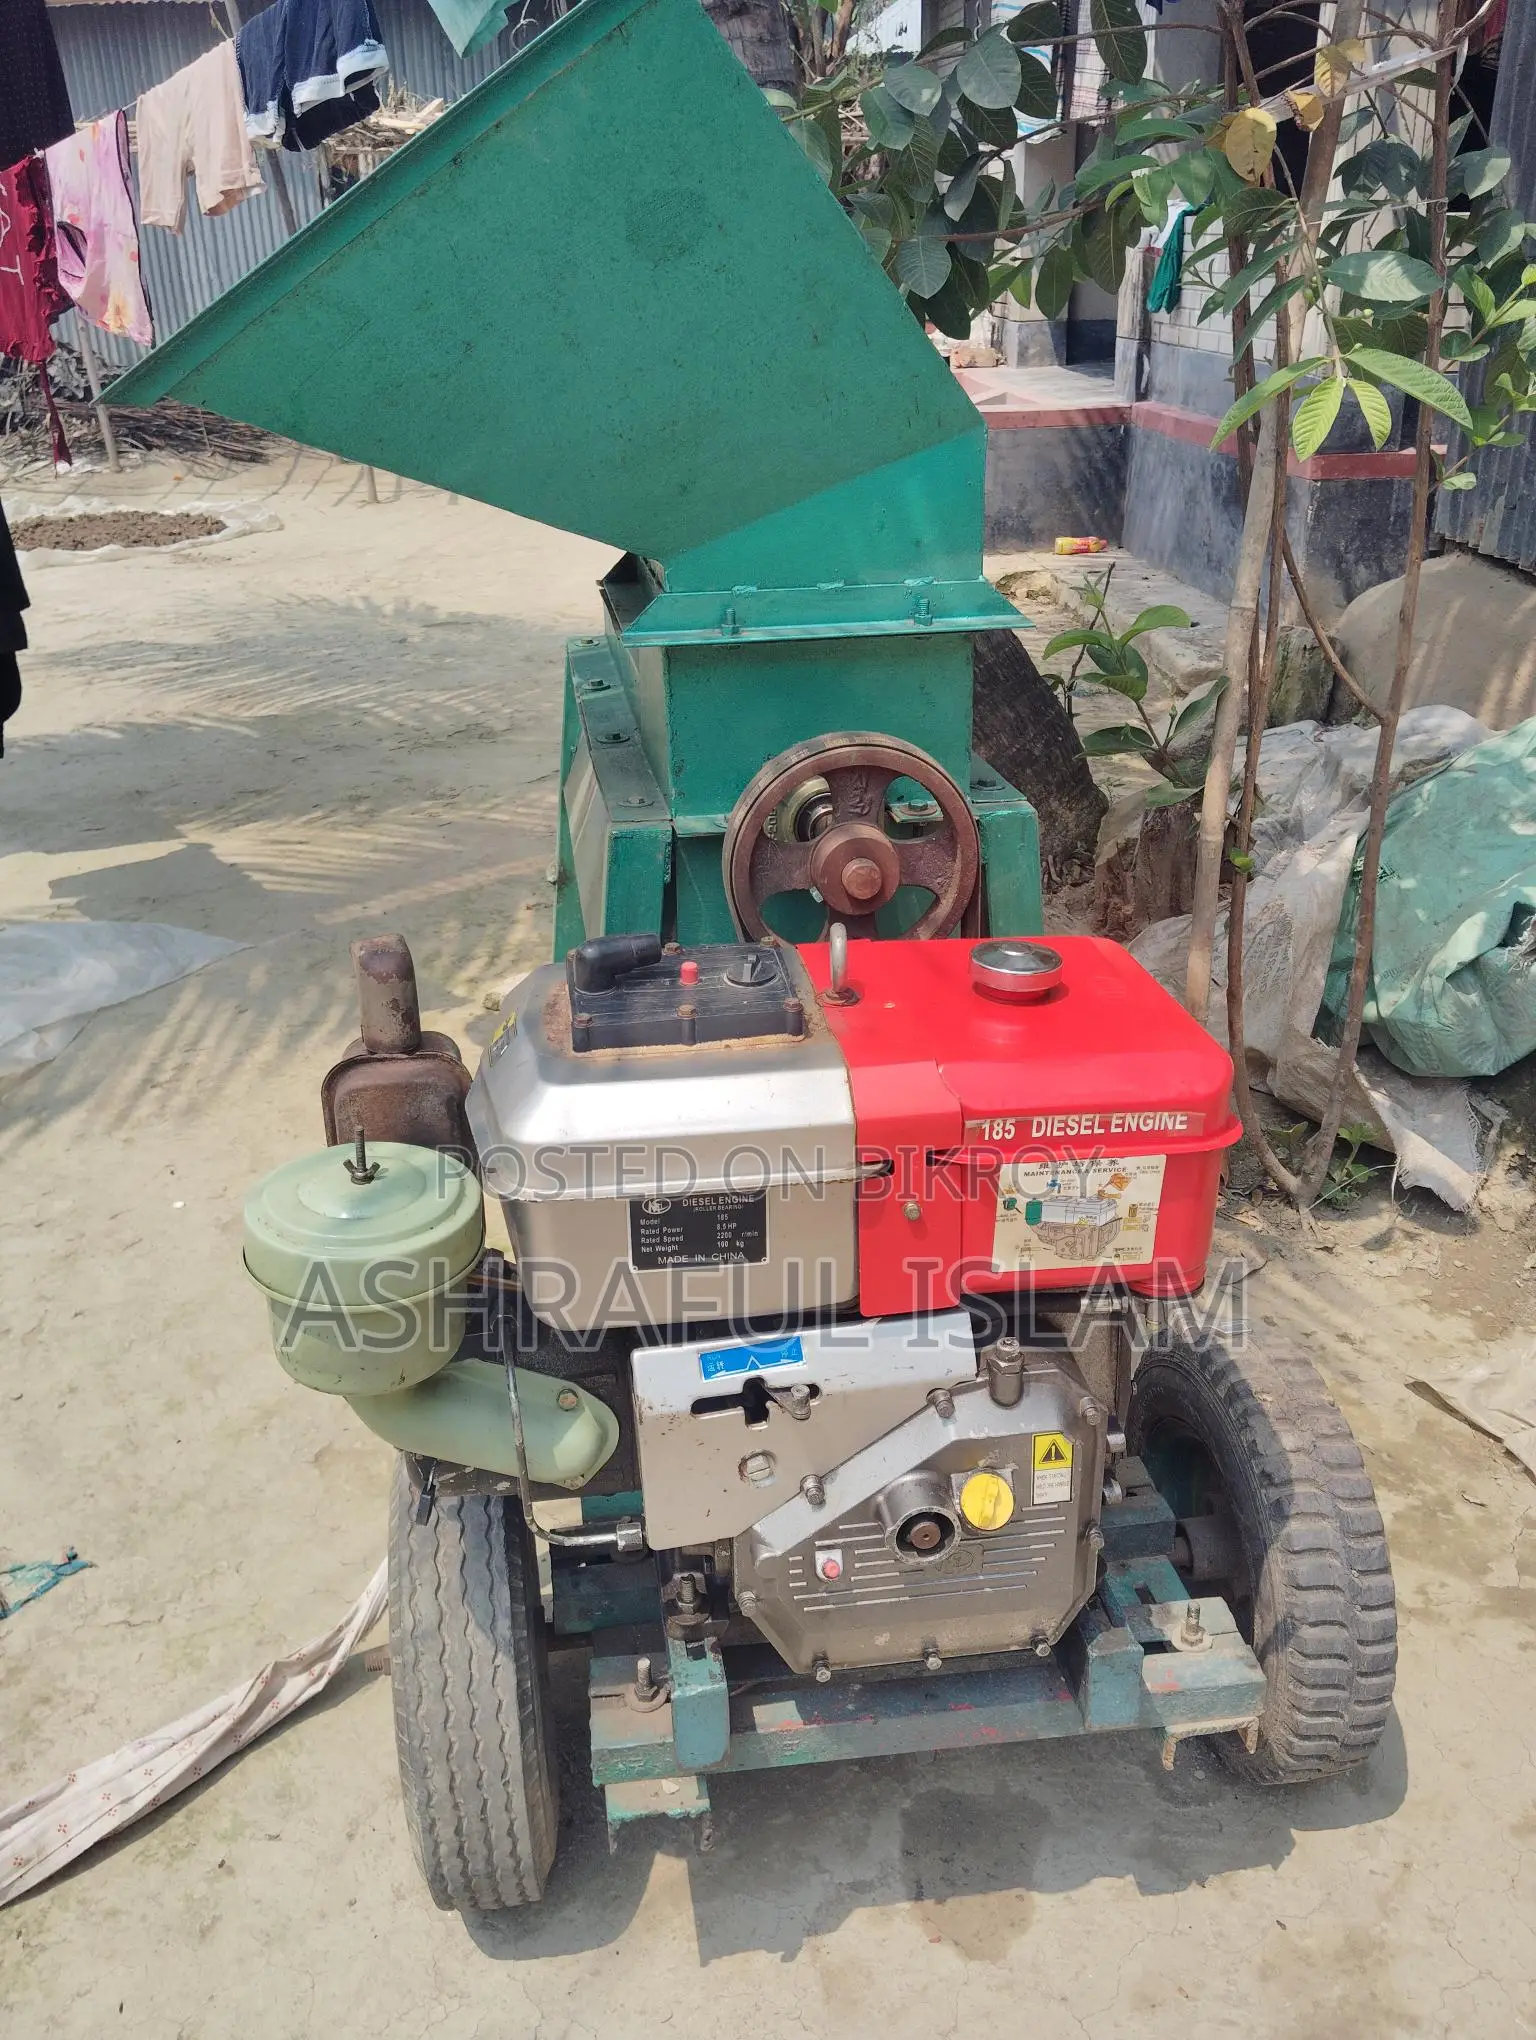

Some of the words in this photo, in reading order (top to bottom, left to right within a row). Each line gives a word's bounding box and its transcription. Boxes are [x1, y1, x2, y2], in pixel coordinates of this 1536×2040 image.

[981, 1119, 1016, 1140] 185
[1031, 1113, 1104, 1138] DIESEL
[1110, 1112, 1188, 1133] ENGINE
[1092, 1166, 1128, 1174] SERVICE
[682, 1196, 716, 1207] DIESEL
[719, 1194, 755, 1204] ENGINE
[640, 1218, 660, 1226] Model
[717, 1213, 729, 1221] 185
[663, 1226, 683, 1234] Power
[717, 1223, 727, 1231] 8.5
[728, 1222, 737, 1230] HP
[641, 1236, 660, 1244] Rated
[663, 1235, 684, 1244] Speed
[741, 1230, 759, 1238] r/min
[655, 1244, 679, 1253] Weight
[736, 1240, 744, 1248] kg
[658, 1255, 689, 1265] MADE
[695, 1254, 706, 1262] IN
[711, 1252, 745, 1261] CHINA
